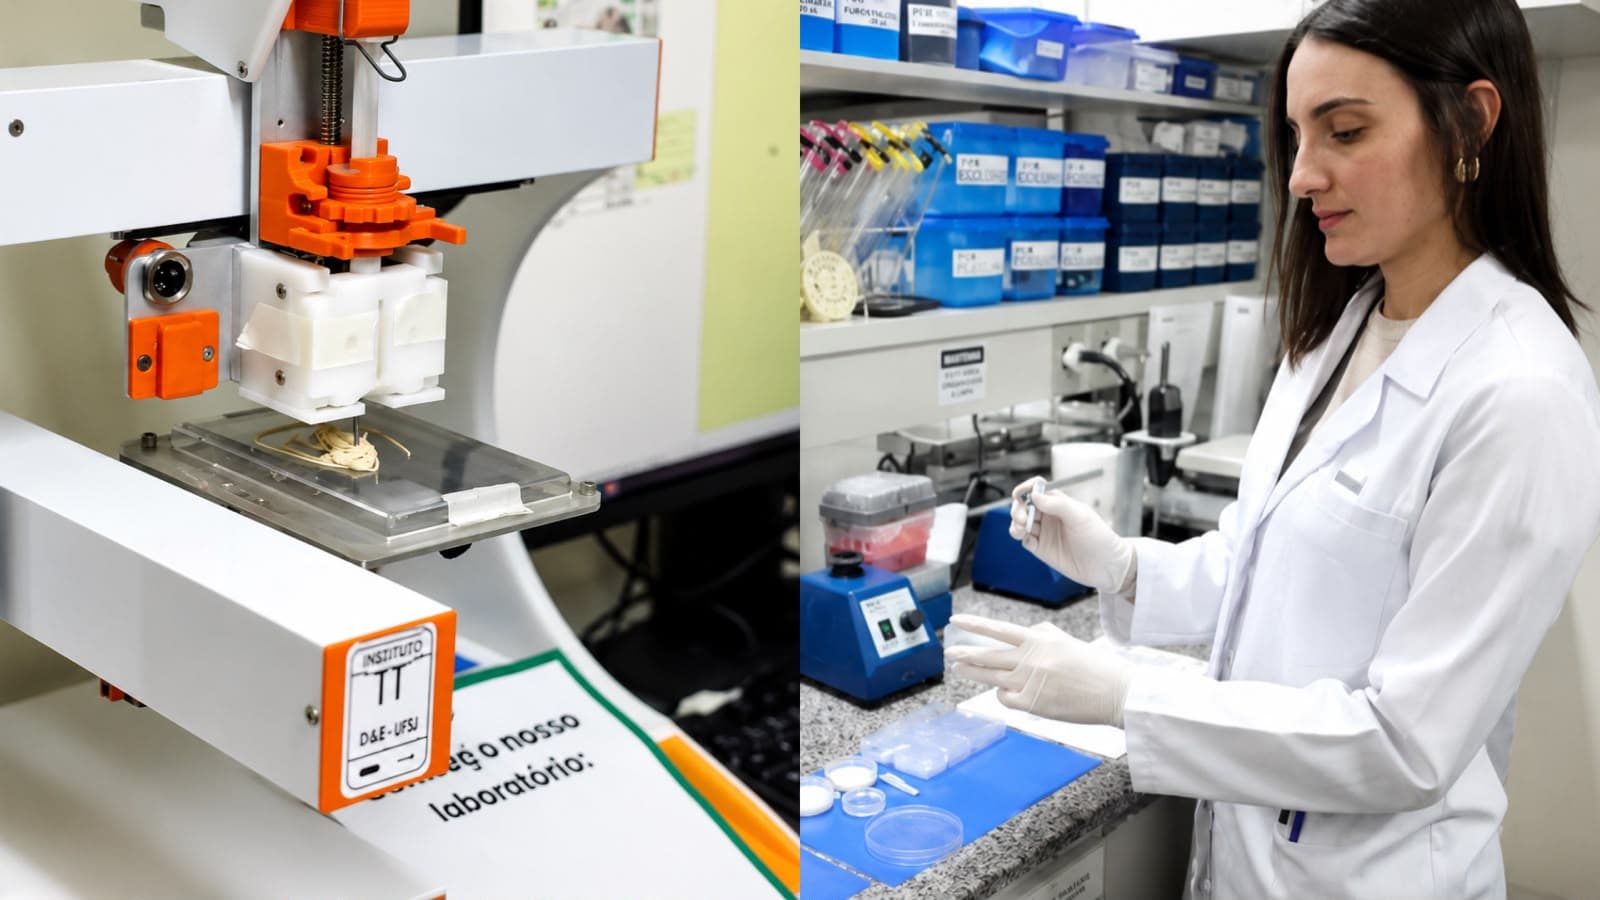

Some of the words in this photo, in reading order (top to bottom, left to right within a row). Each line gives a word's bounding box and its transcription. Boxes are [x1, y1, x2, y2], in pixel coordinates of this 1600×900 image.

[363, 640, 423, 668] INSTITUTO
[478, 743, 499, 758] o
[499, 714, 580, 752] nosso
[428, 753, 594, 822] laboratório:
